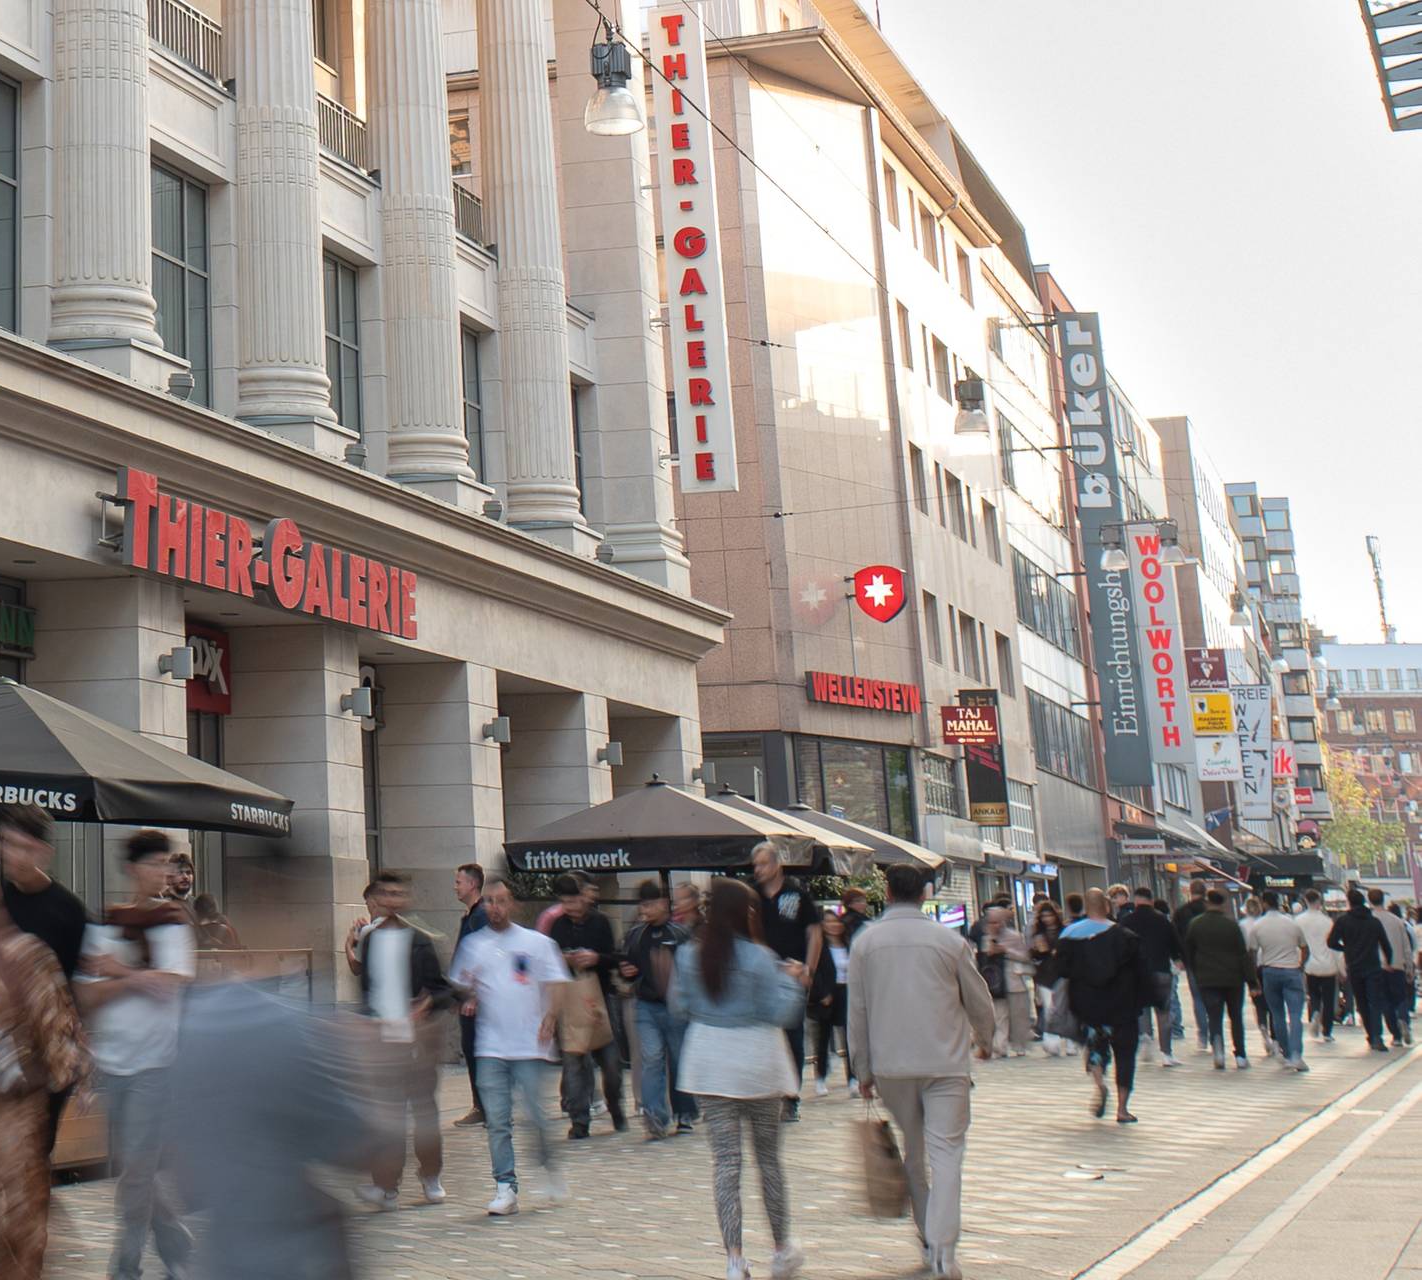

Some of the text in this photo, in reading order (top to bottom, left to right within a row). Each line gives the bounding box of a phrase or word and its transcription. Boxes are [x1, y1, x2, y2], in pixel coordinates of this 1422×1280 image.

[661, 14, 715, 481] THIER-GALERIE
[126, 467, 418, 641] THIER-GALERIE
[1135, 535, 1181, 748] WOOLWORTH
[810, 670, 922, 714] WELLENSTEYN
[1229, 688, 1268, 700] FREIE
[946, 719, 994, 732] MAHAL
[956, 707, 981, 719] TAJ
[1234, 703, 1258, 795] WAFFEN
[230, 802, 290, 833] STARBUCKS
[524, 849, 631, 869] frittenwerk
